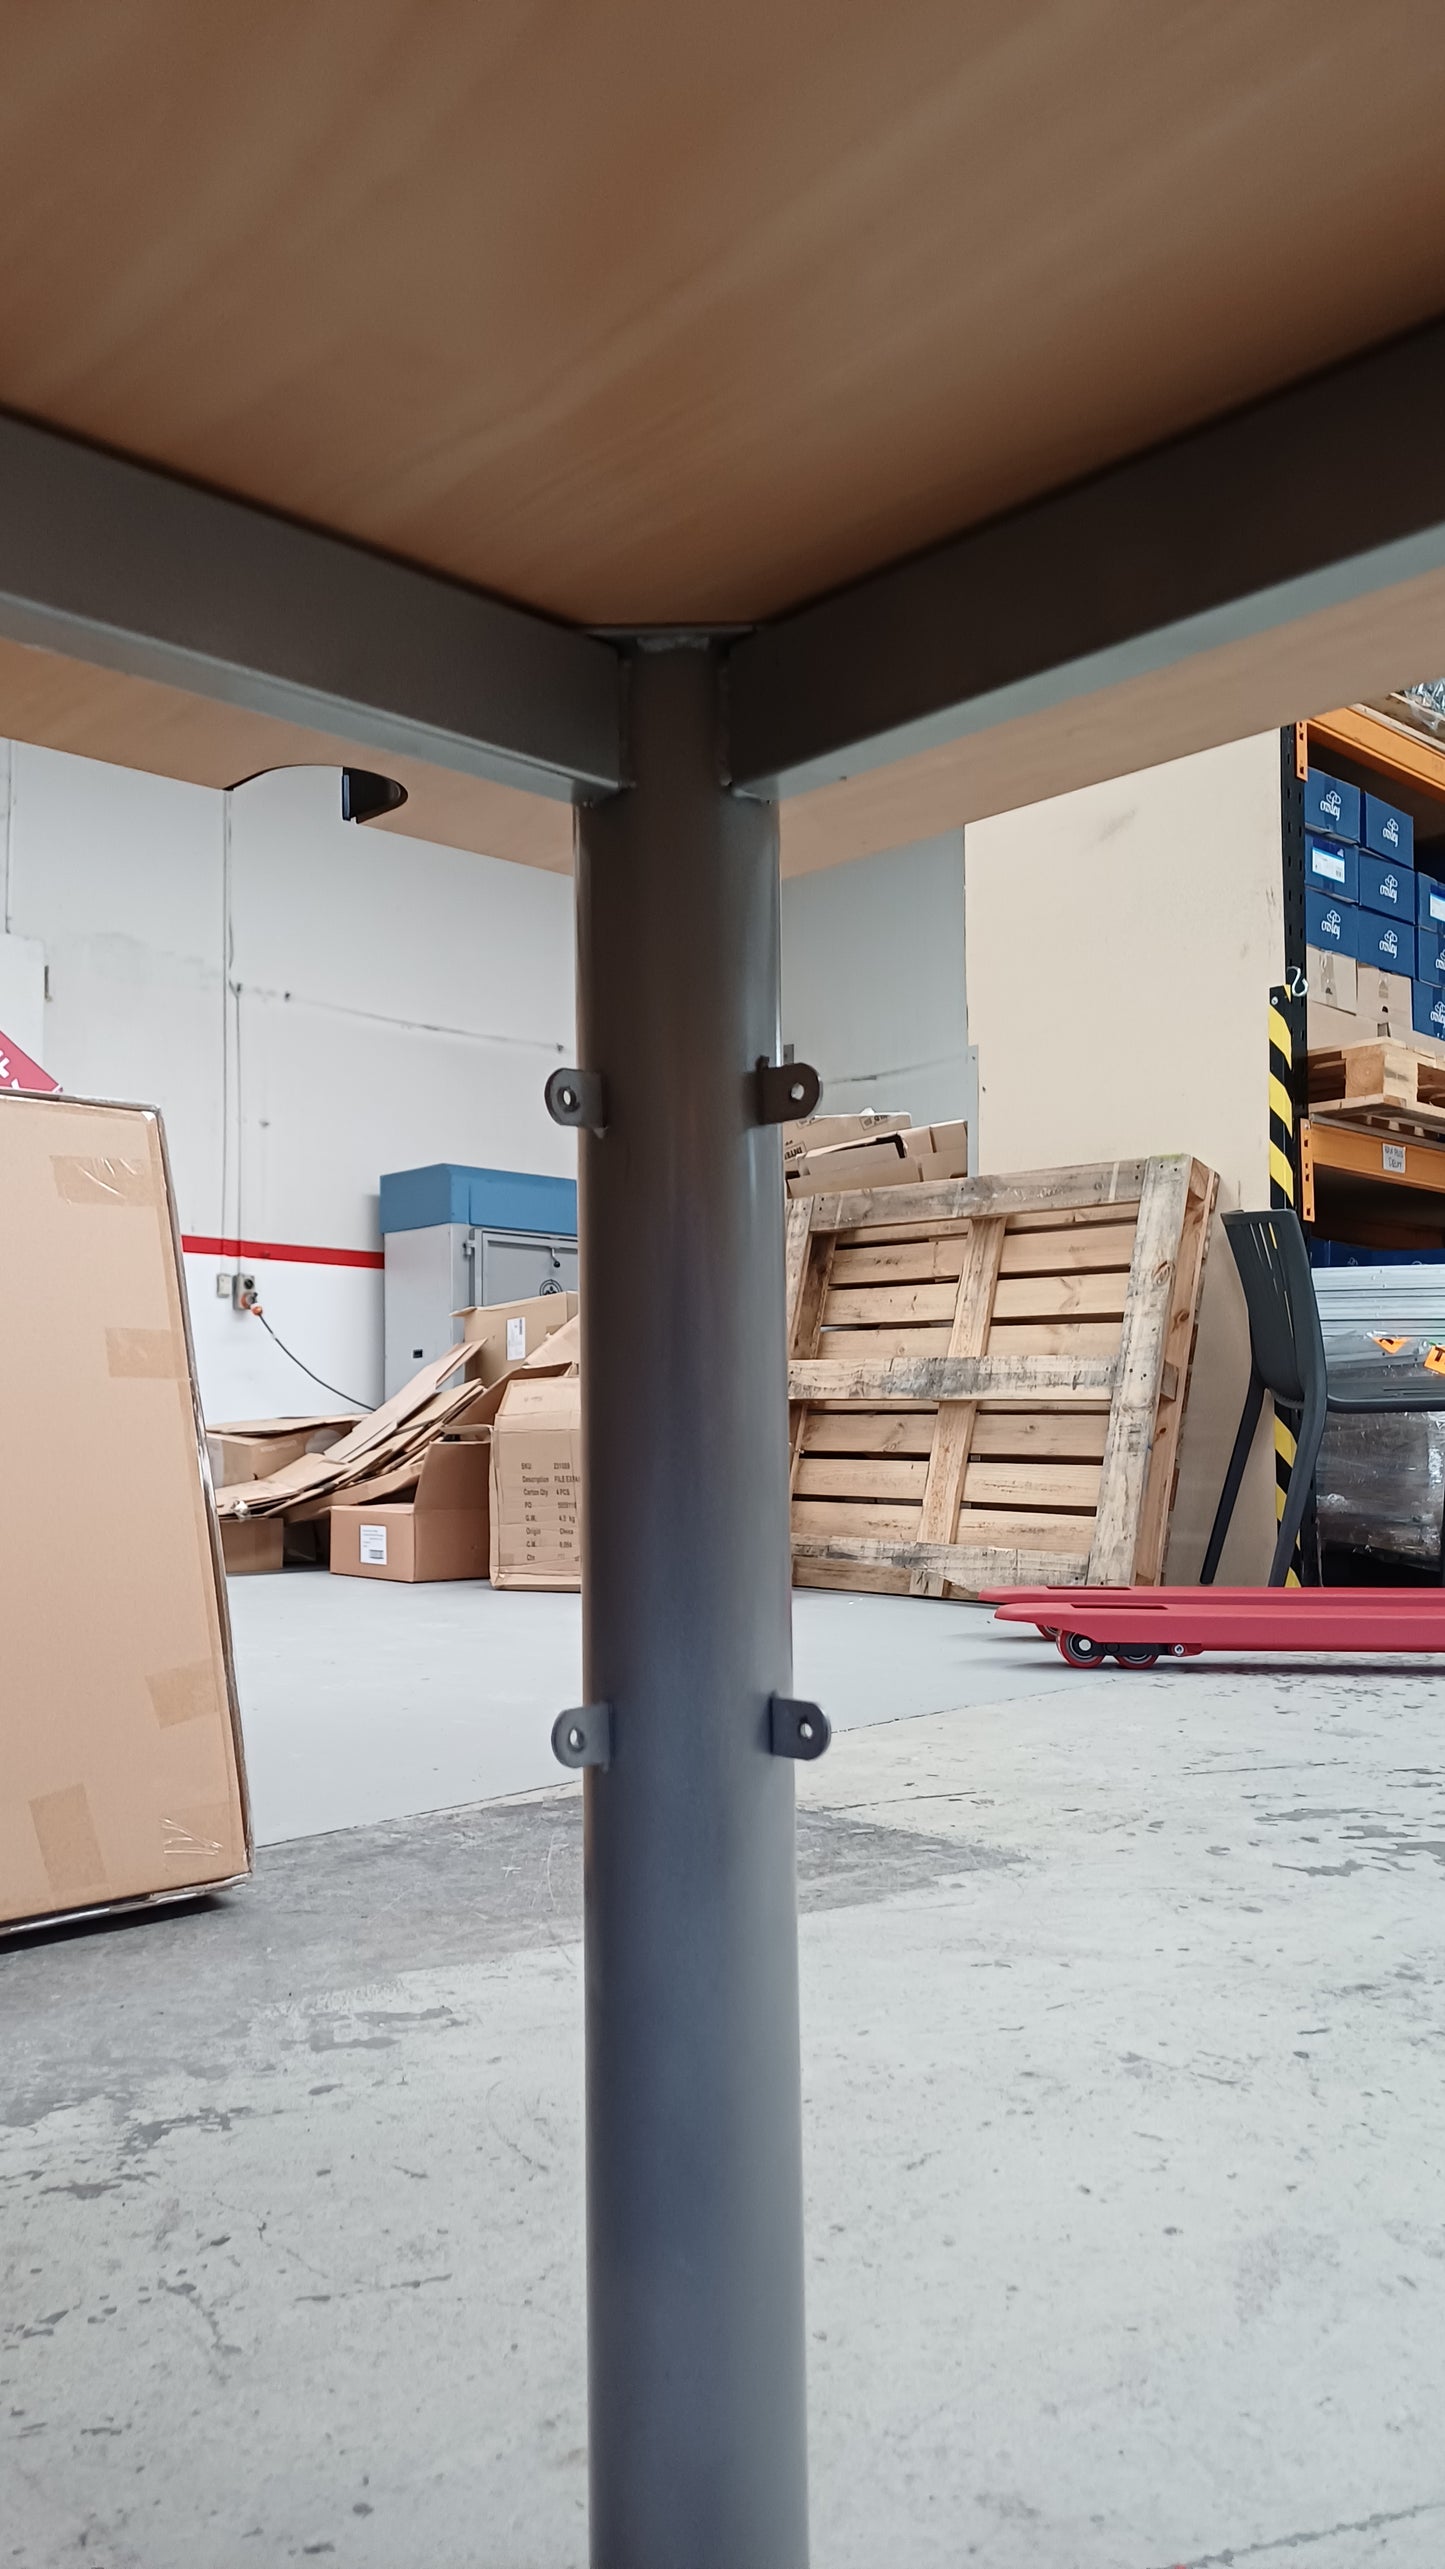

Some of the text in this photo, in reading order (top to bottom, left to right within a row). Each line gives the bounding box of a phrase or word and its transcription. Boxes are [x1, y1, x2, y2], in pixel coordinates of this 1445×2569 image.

[522, 1475, 549, 1484] Description
[523, 1488, 539, 1496] Carton
[526, 1527, 541, 1537] Origin
